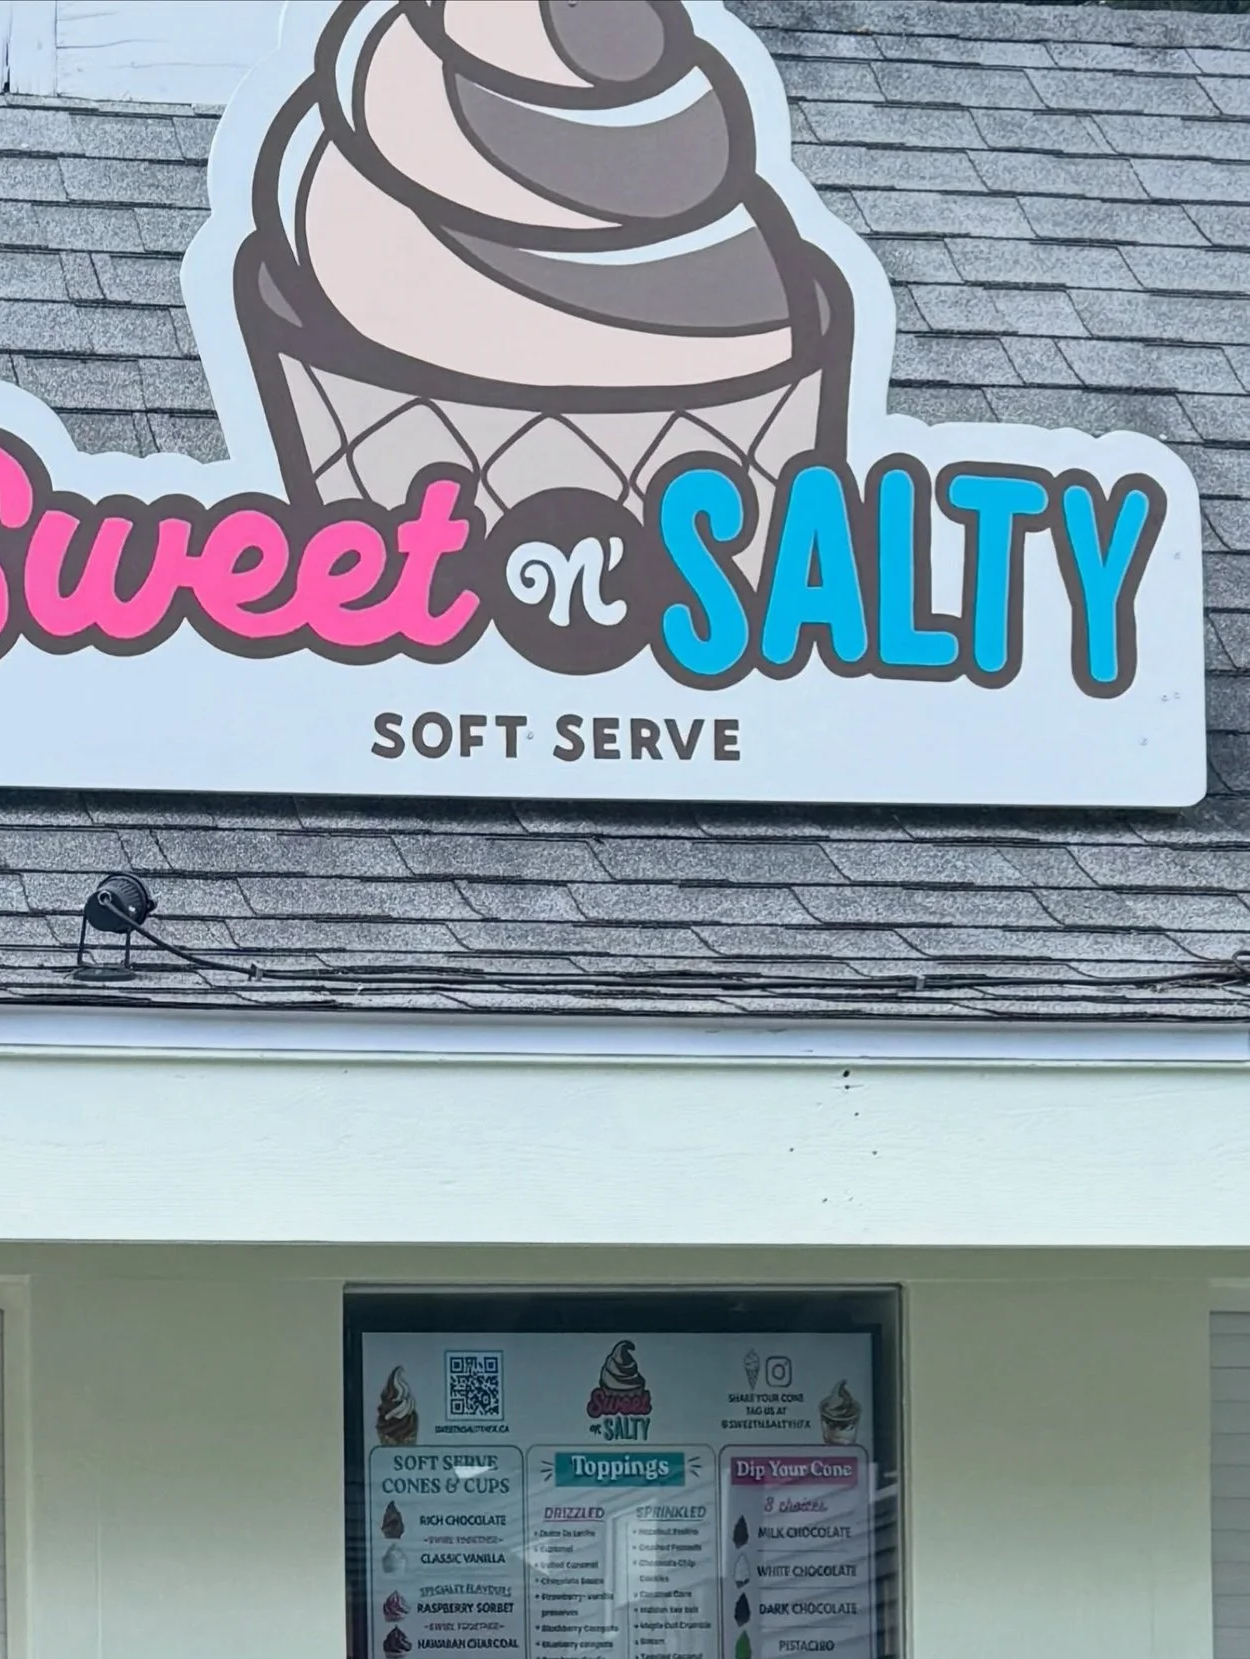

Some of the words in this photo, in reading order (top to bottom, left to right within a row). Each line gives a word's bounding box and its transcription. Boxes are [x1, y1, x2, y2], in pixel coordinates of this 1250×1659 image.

[658, 468, 1150, 683] SALTY
[371, 712, 526, 763] SOFT
[553, 715, 742, 761] SERVE
[588, 1388, 652, 1418] Sweet
[776, 1406, 787, 1415] AT
[604, 1416, 650, 1441] SALTY
[394, 1455, 438, 1471] SOFT
[443, 1454, 499, 1471] SERVE
[572, 1456, 670, 1480] Toppings
[737, 1461, 765, 1480] Dip
[769, 1461, 808, 1477] Your
[811, 1460, 852, 1476] Cone
[382, 1478, 442, 1494] CONES
[446, 1477, 460, 1494] &
[464, 1478, 510, 1494] CUPS
[764, 1496, 774, 1512] 8
[544, 1506, 606, 1520] DRIZZLED
[636, 1505, 706, 1519] SPRINKLED
[420, 1515, 444, 1526] RICH
[446, 1514, 506, 1526] CHOCOLATE
[758, 1527, 785, 1539] MILK
[786, 1526, 852, 1538] CHOCOLATE
[420, 1553, 462, 1564] CLASSIC
[463, 1553, 506, 1564] VANILLA
[757, 1565, 790, 1576] WHITE
[792, 1565, 857, 1576] CHOCOLATE
[417, 1602, 474, 1614] RASPBERRY
[477, 1602, 515, 1614] SORBET
[759, 1603, 789, 1615] DARK
[792, 1603, 858, 1615] CHOCOLATE
[418, 1638, 466, 1650] HAWAIIAN
[468, 1638, 520, 1649] CHARCOAL
[779, 1640, 835, 1652] PISTACHIO
